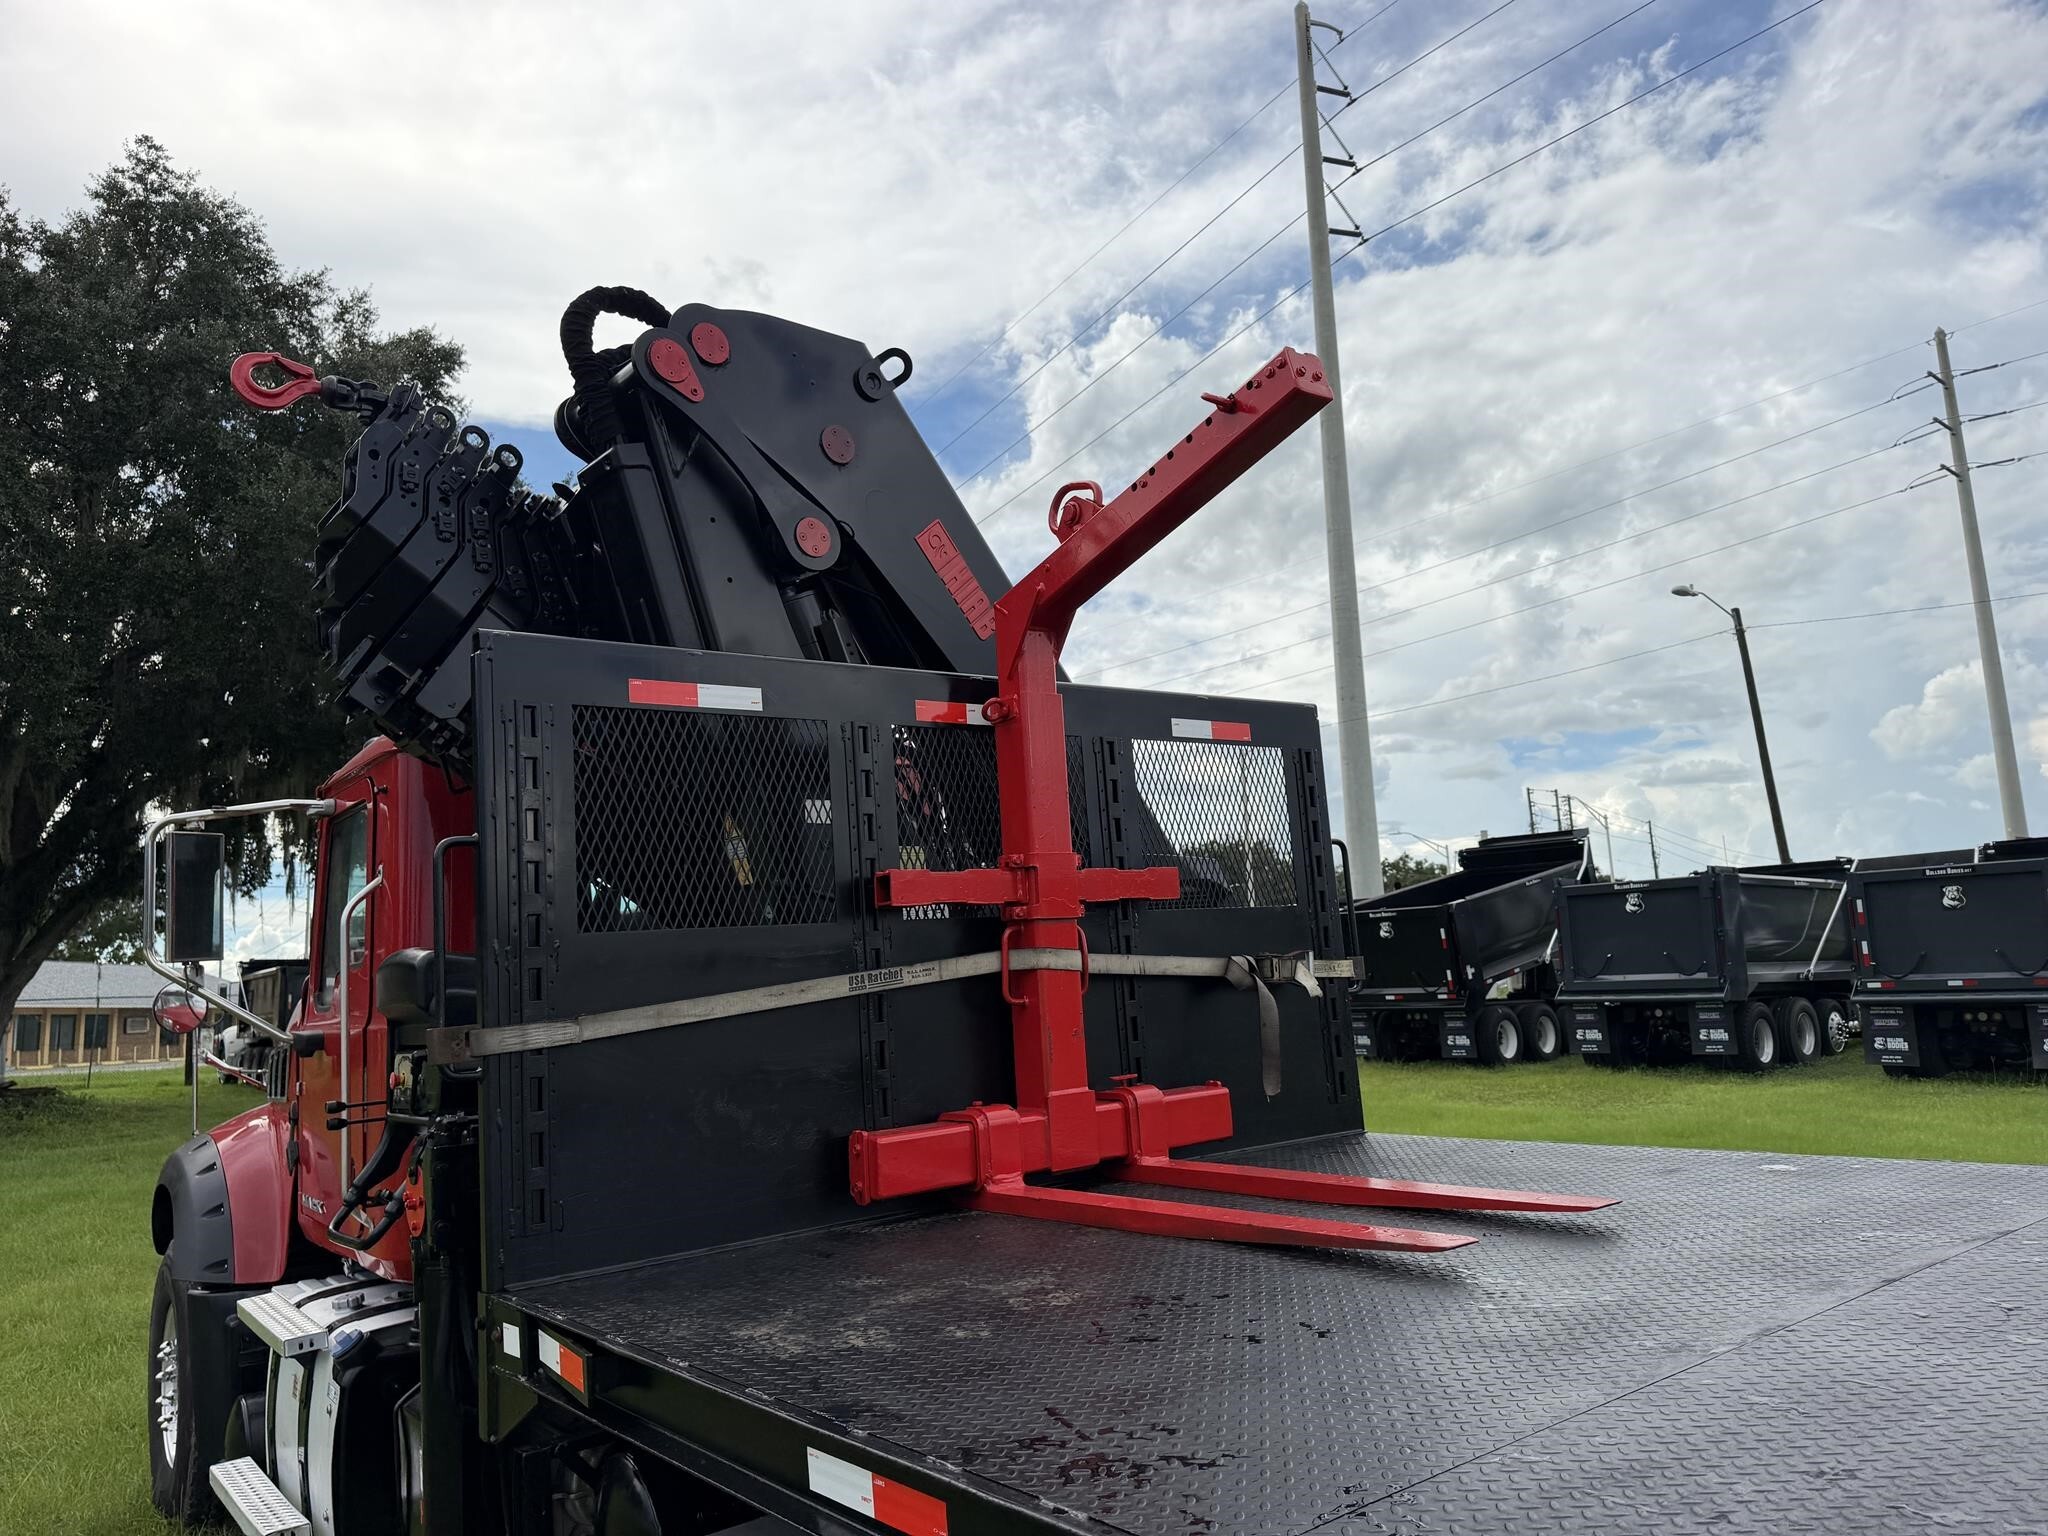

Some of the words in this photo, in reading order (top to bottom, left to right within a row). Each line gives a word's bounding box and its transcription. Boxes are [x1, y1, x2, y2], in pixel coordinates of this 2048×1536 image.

[938, 555, 995, 641] HIAB
[848, 973, 866, 987] USA
[867, 967, 904, 984] Ratchet
